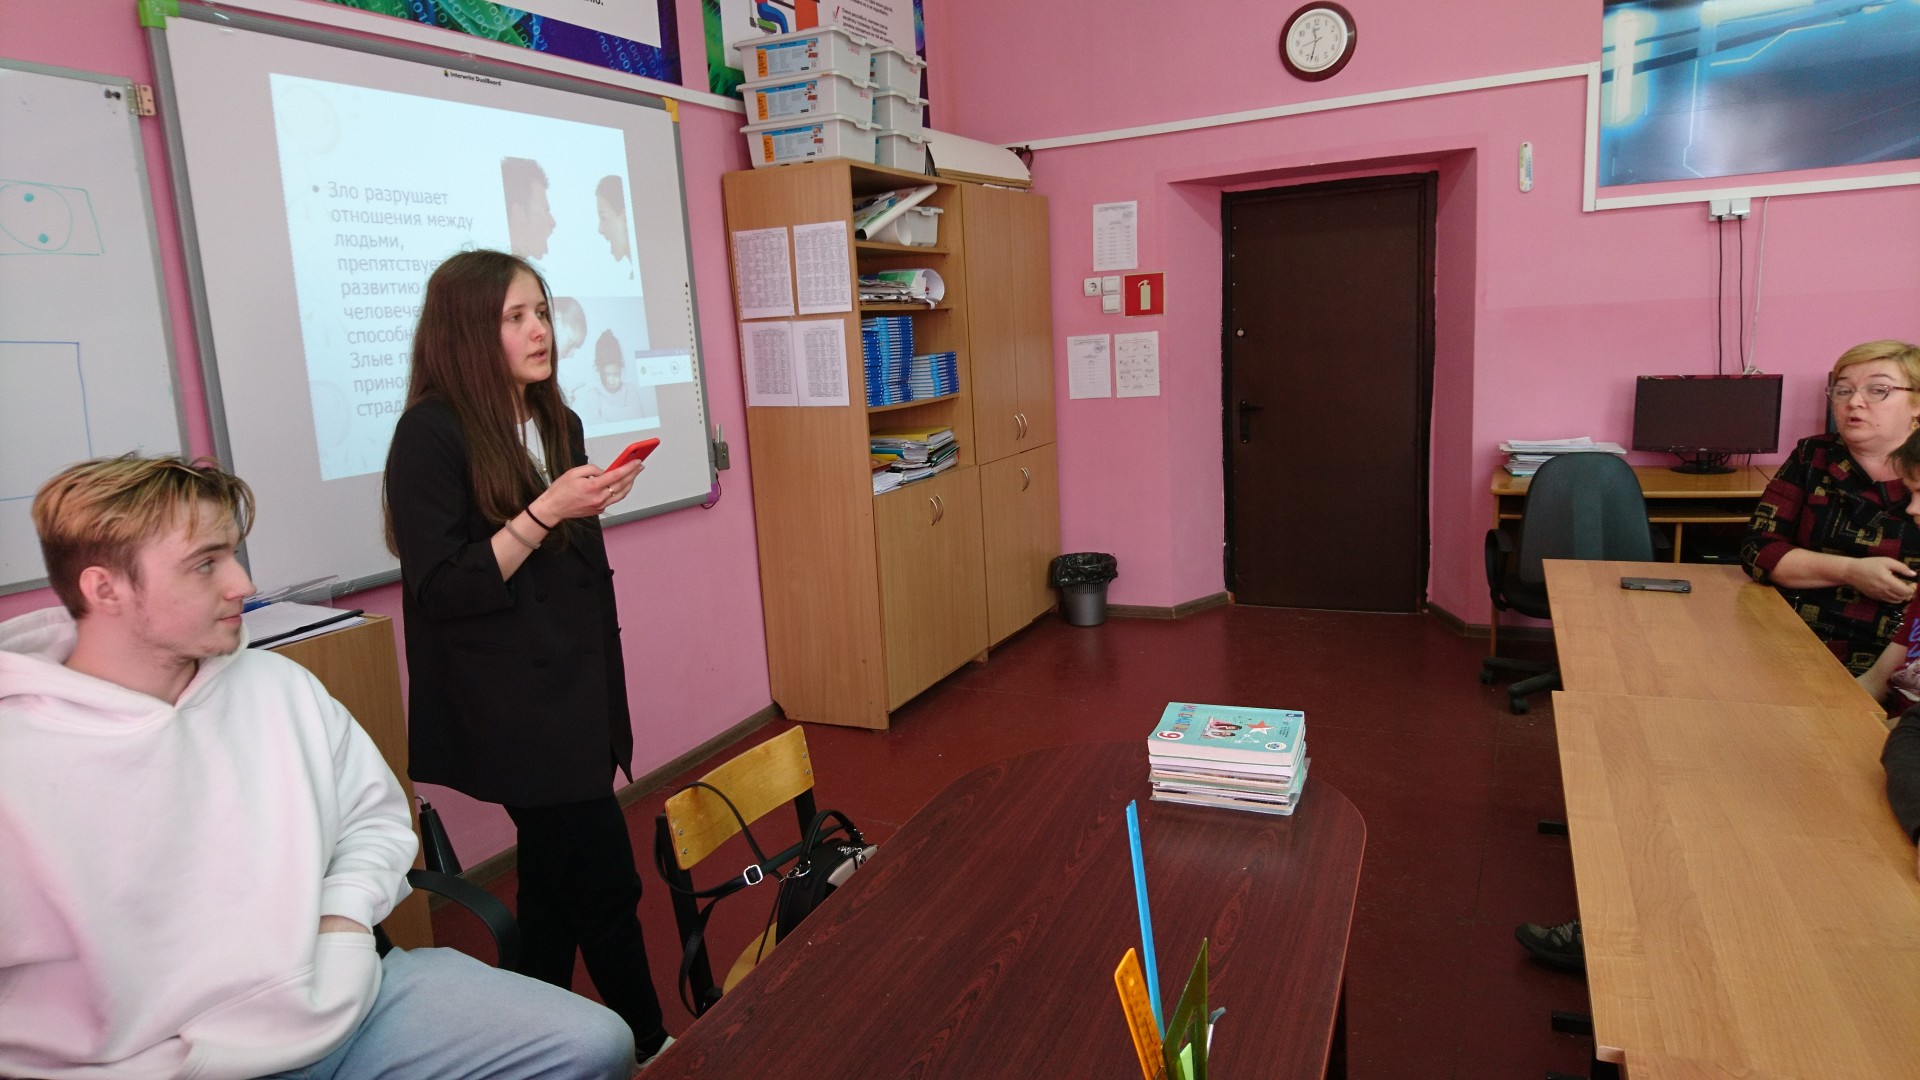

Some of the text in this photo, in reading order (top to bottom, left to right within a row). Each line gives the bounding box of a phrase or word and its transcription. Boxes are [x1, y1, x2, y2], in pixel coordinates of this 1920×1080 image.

[327, 181, 448, 206] Зло разрушает
[331, 208, 473, 232] отношения между
[334, 233, 405, 251] людьми,
[341, 281, 420, 299] развитию
[343, 305, 424, 320] человече
[347, 325, 415, 345] способн
[349, 352, 393, 369] Злые
[357, 400, 404, 418] страд
